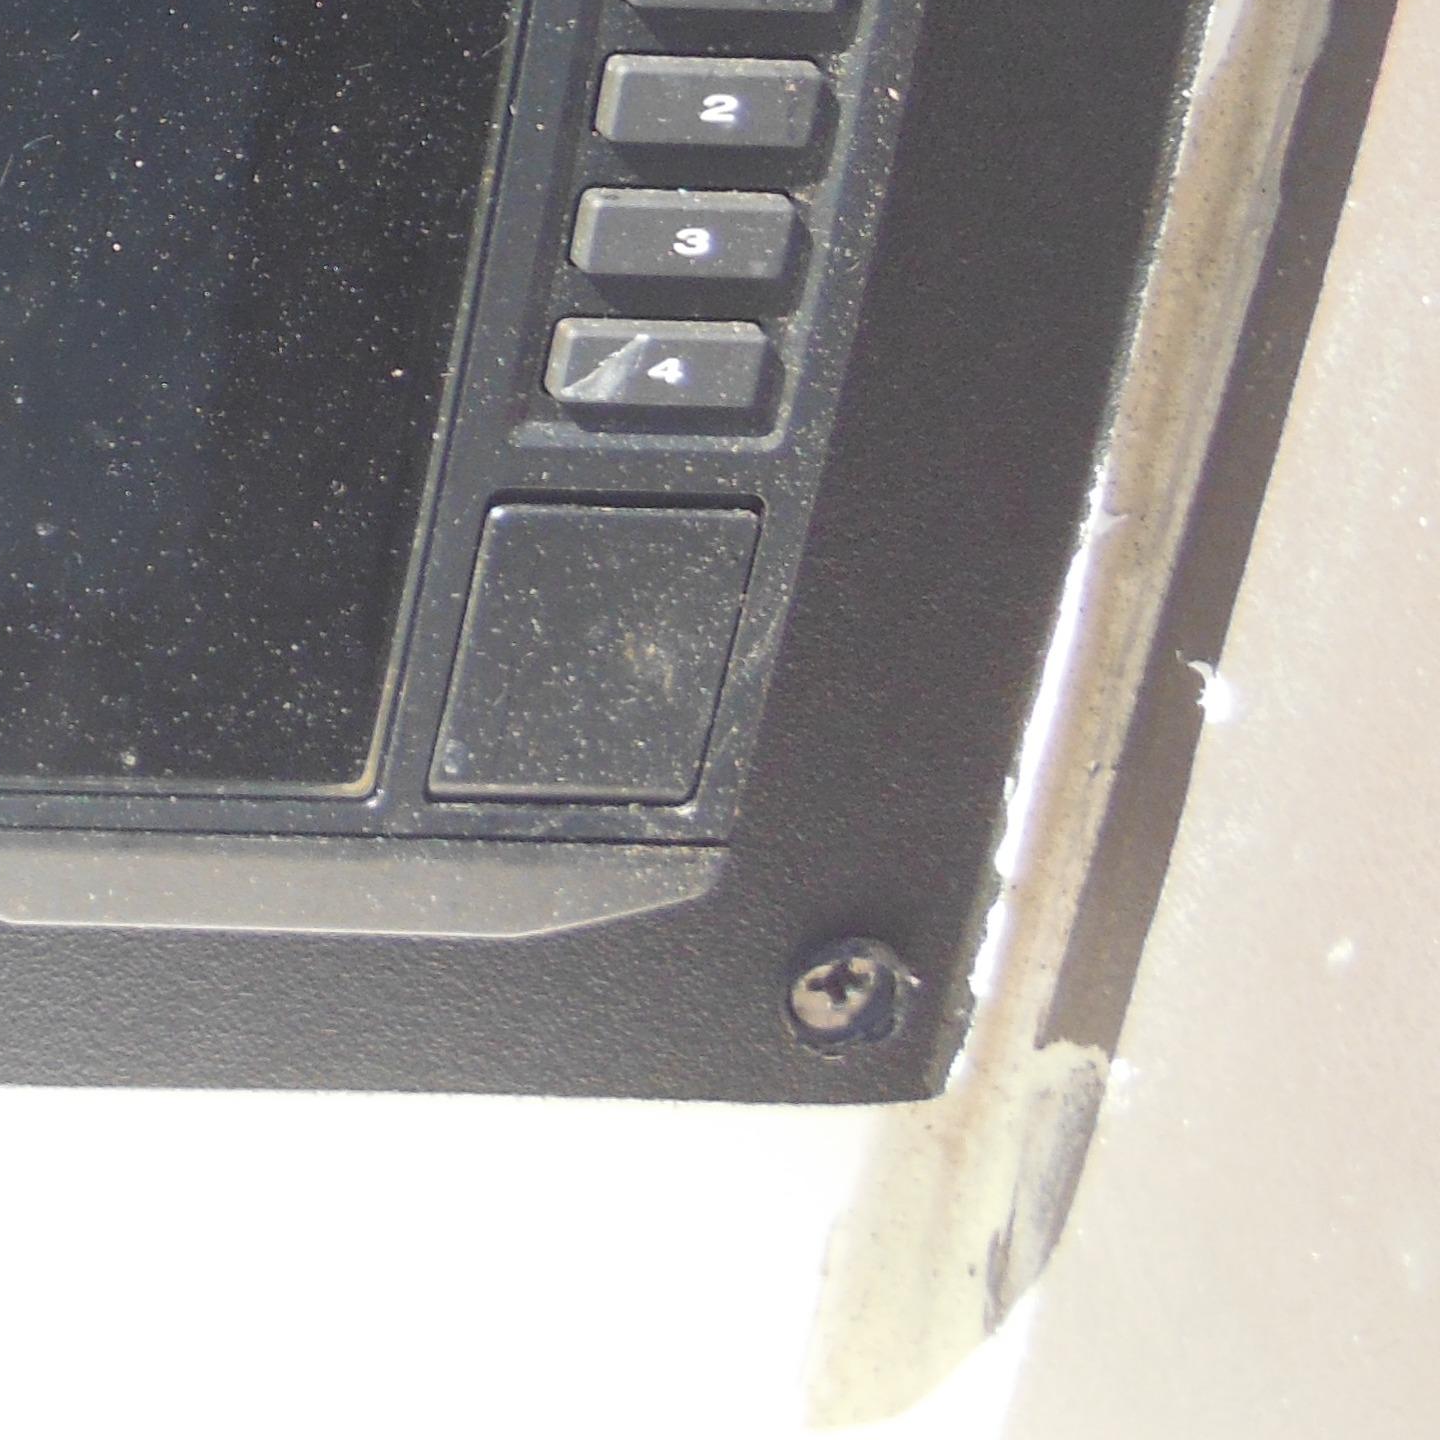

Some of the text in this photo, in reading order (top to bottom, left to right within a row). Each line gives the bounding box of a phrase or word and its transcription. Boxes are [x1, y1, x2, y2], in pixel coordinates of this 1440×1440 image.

[699, 93, 739, 124] 2
[672, 227, 712, 257] 3
[646, 357, 684, 385] 4
